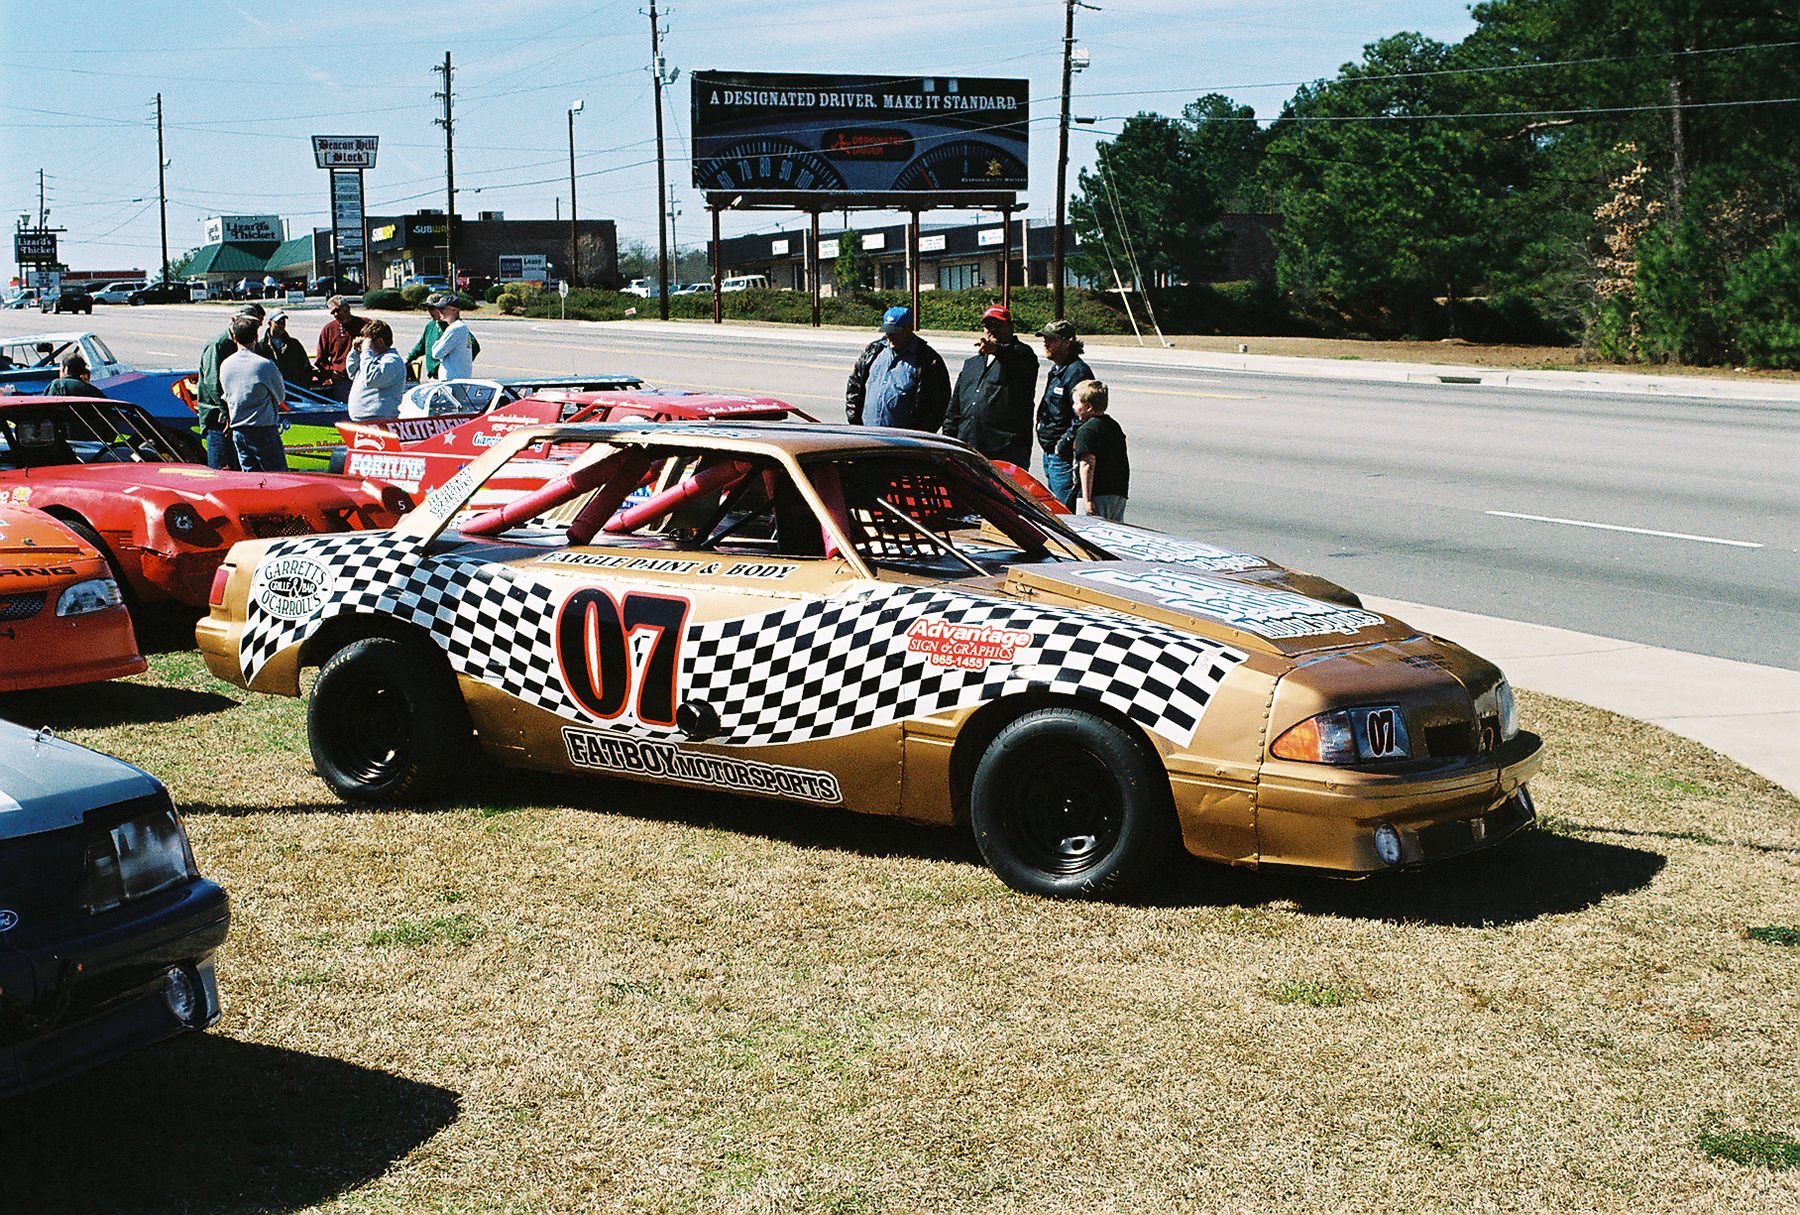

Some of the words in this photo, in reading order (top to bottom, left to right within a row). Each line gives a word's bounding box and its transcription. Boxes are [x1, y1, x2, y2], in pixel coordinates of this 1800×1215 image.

[710, 91, 720, 104] A
[724, 91, 816, 107] DESIGNATED
[819, 92, 877, 108] DRIVER.
[883, 94, 923, 109] MAKE
[926, 95, 940, 109] IT
[943, 95, 1017, 110] STANDARD.
[318, 139, 354, 150] Beacon
[355, 139, 375, 150] Hill
[333, 152, 363, 162] Block
[737, 159, 752, 181] 70
[759, 156, 771, 177] 80
[779, 159, 792, 181] 90
[795, 168, 814, 189] 100
[226, 222, 270, 231] Lizard's
[231, 231, 276, 240] Thicket
[413, 225, 448, 234] SUBWA
[18, 237, 52, 246] Lizard's
[20, 246, 55, 254] Thicket
[387, 418, 470, 440] EXCITEME
[349, 453, 426, 480] FORTUNE
[264, 559, 327, 585] GARRETT'S
[627, 558, 700, 572] PAINT
[699, 563, 720, 574] &
[726, 563, 796, 578] BODY
[289, 576, 303, 599] &
[262, 590, 321, 616] O'CARROLL'S
[908, 619, 1032, 648] Advantage
[556, 585, 690, 727] 07
[910, 638, 939, 653] SIGN
[941, 641, 952, 654] &
[953, 643, 1014, 660] GRAPHICS
[931, 653, 984, 669] 865-1455
[1367, 708, 1396, 758] 07
[566, 732, 679, 775] FATBOY
[675, 755, 838, 801] MOTORSPORTS
